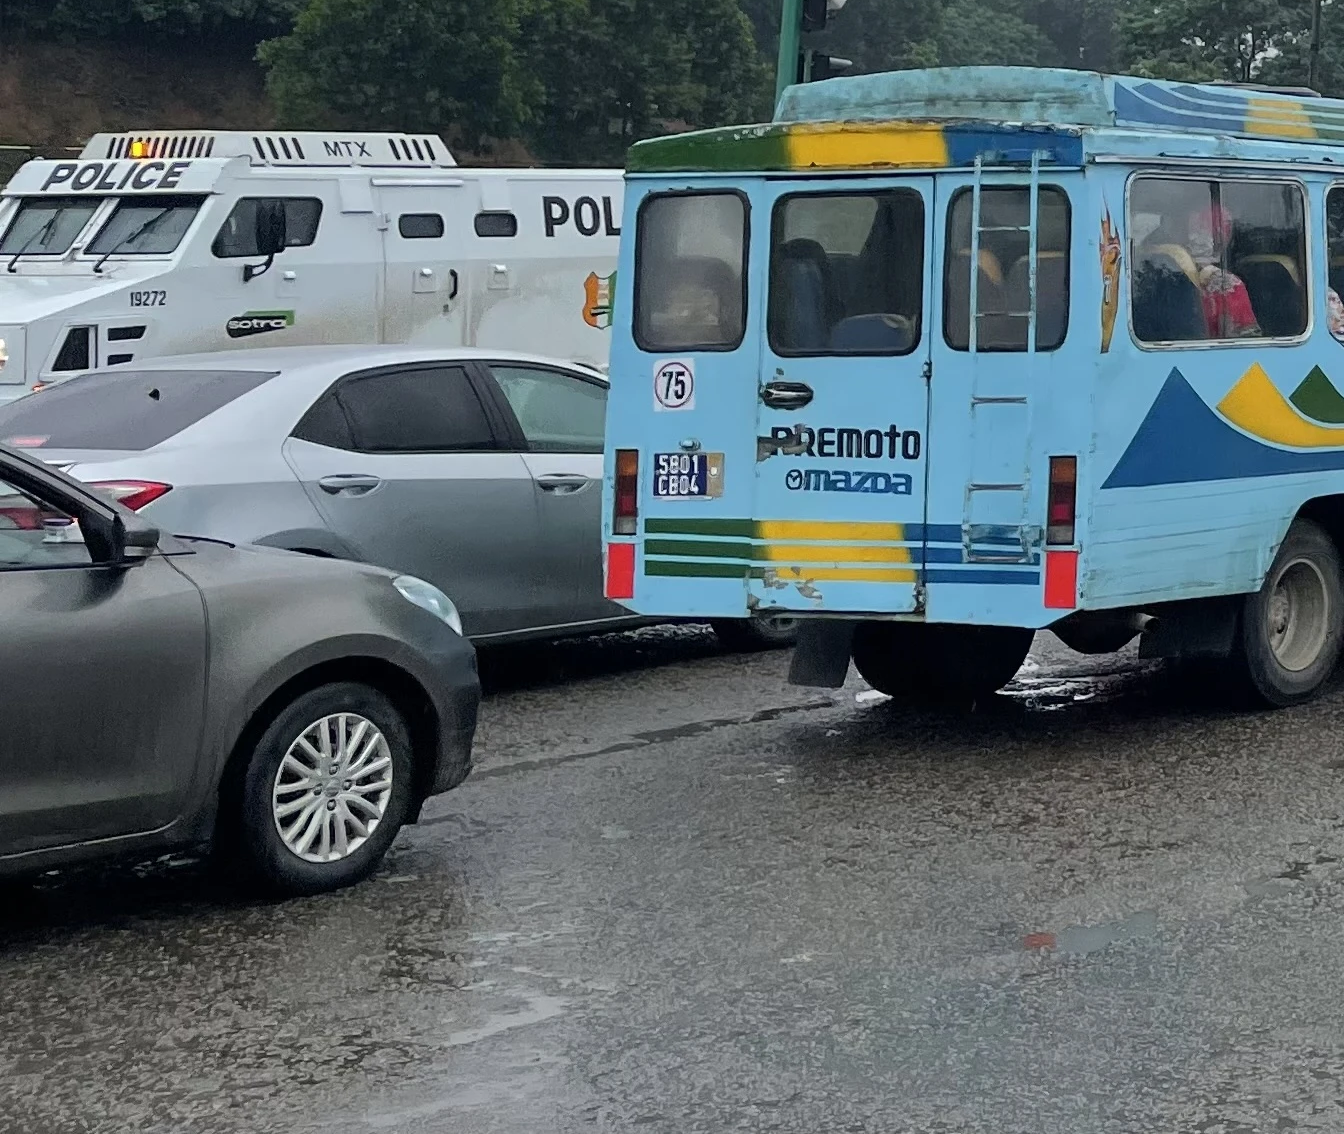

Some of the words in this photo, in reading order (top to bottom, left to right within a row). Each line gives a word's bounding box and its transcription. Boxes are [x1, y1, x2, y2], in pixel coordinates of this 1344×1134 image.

[323, 141, 372, 157] MTX
[40, 161, 193, 191] POLICE
[130, 291, 167, 307] 19272
[662, 370, 686, 400] 75
